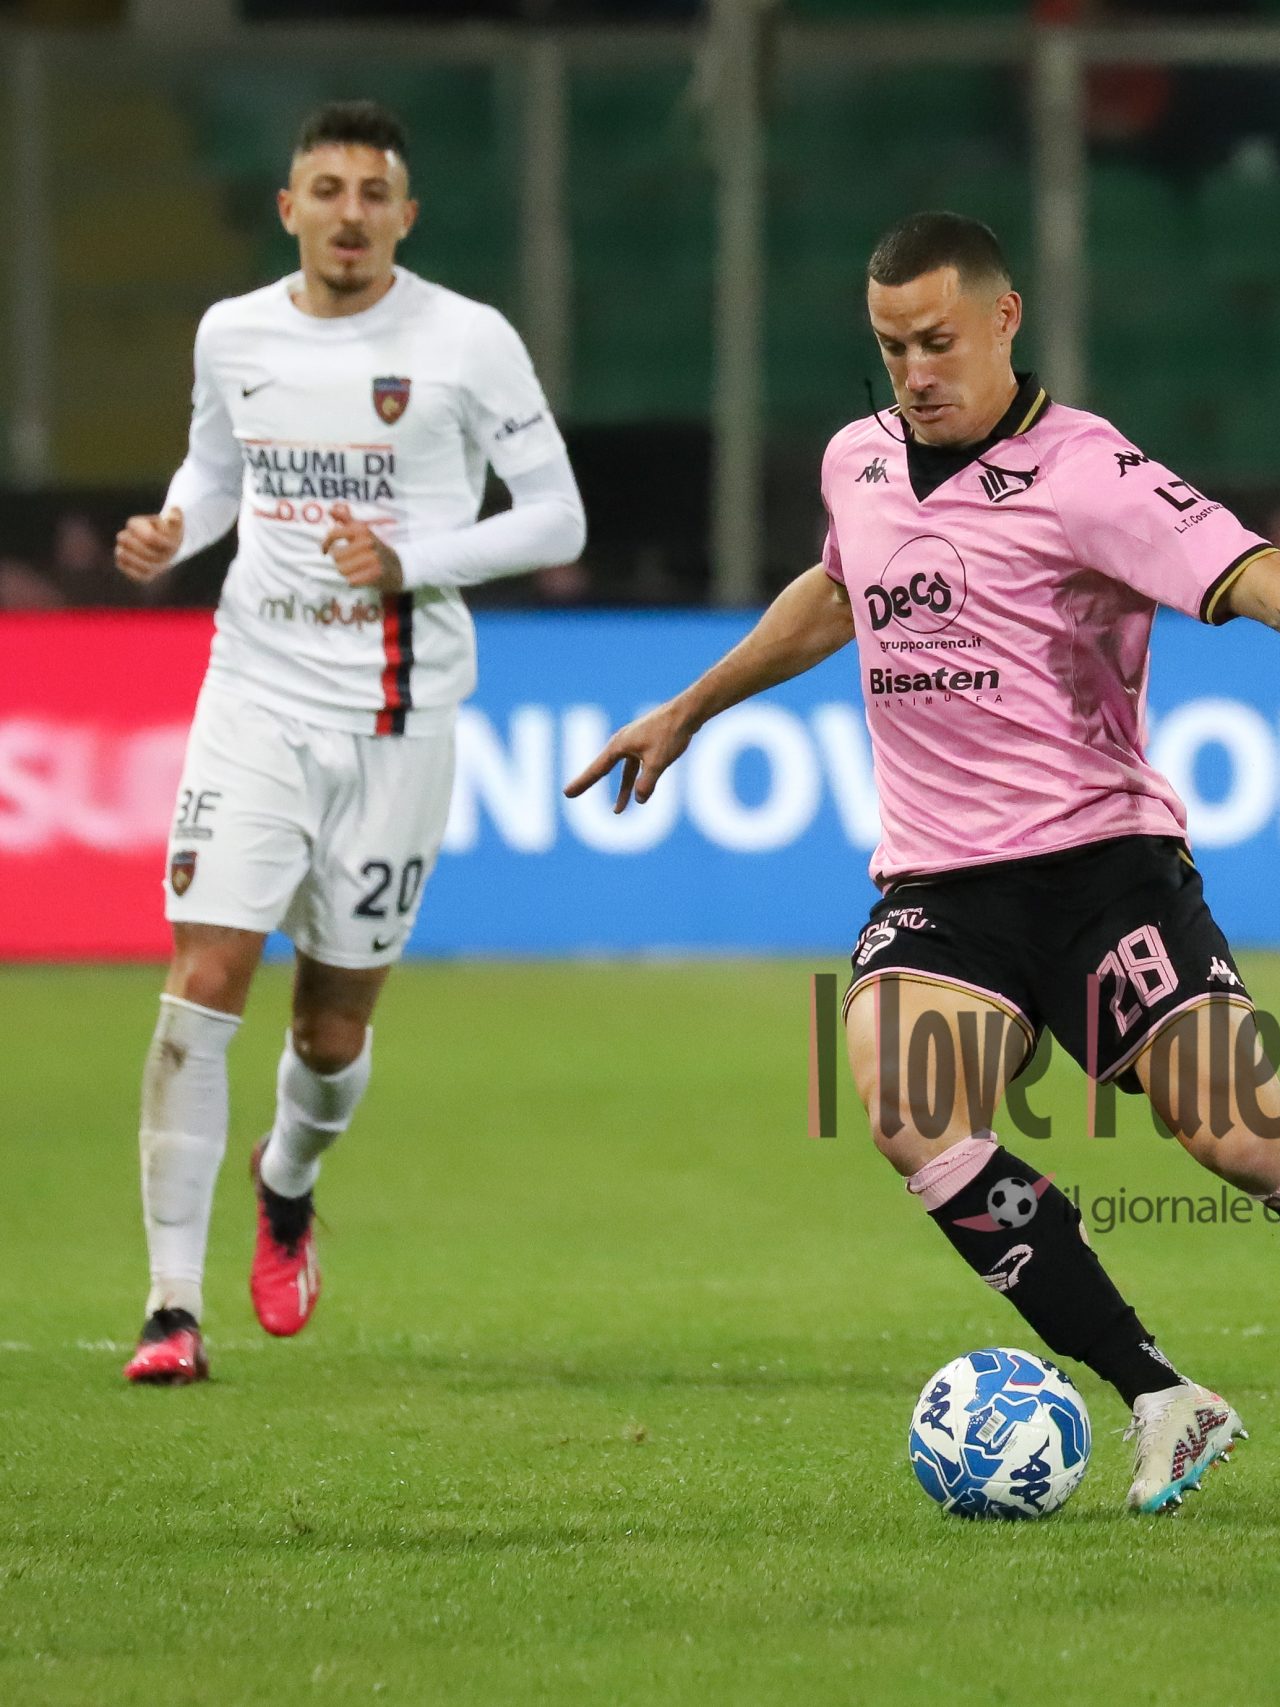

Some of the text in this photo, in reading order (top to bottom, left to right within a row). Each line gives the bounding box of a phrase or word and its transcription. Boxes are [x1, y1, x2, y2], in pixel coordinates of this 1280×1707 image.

[364, 453, 396, 476] DI
[256, 474, 395, 501] ALABRIA
[278, 499, 324, 524] DO
[880, 635, 982, 653] gruppoarena.it
[870, 667, 1000, 695] Bisaten
[354, 857, 423, 918] 20
[1096, 924, 1179, 1037] 28
